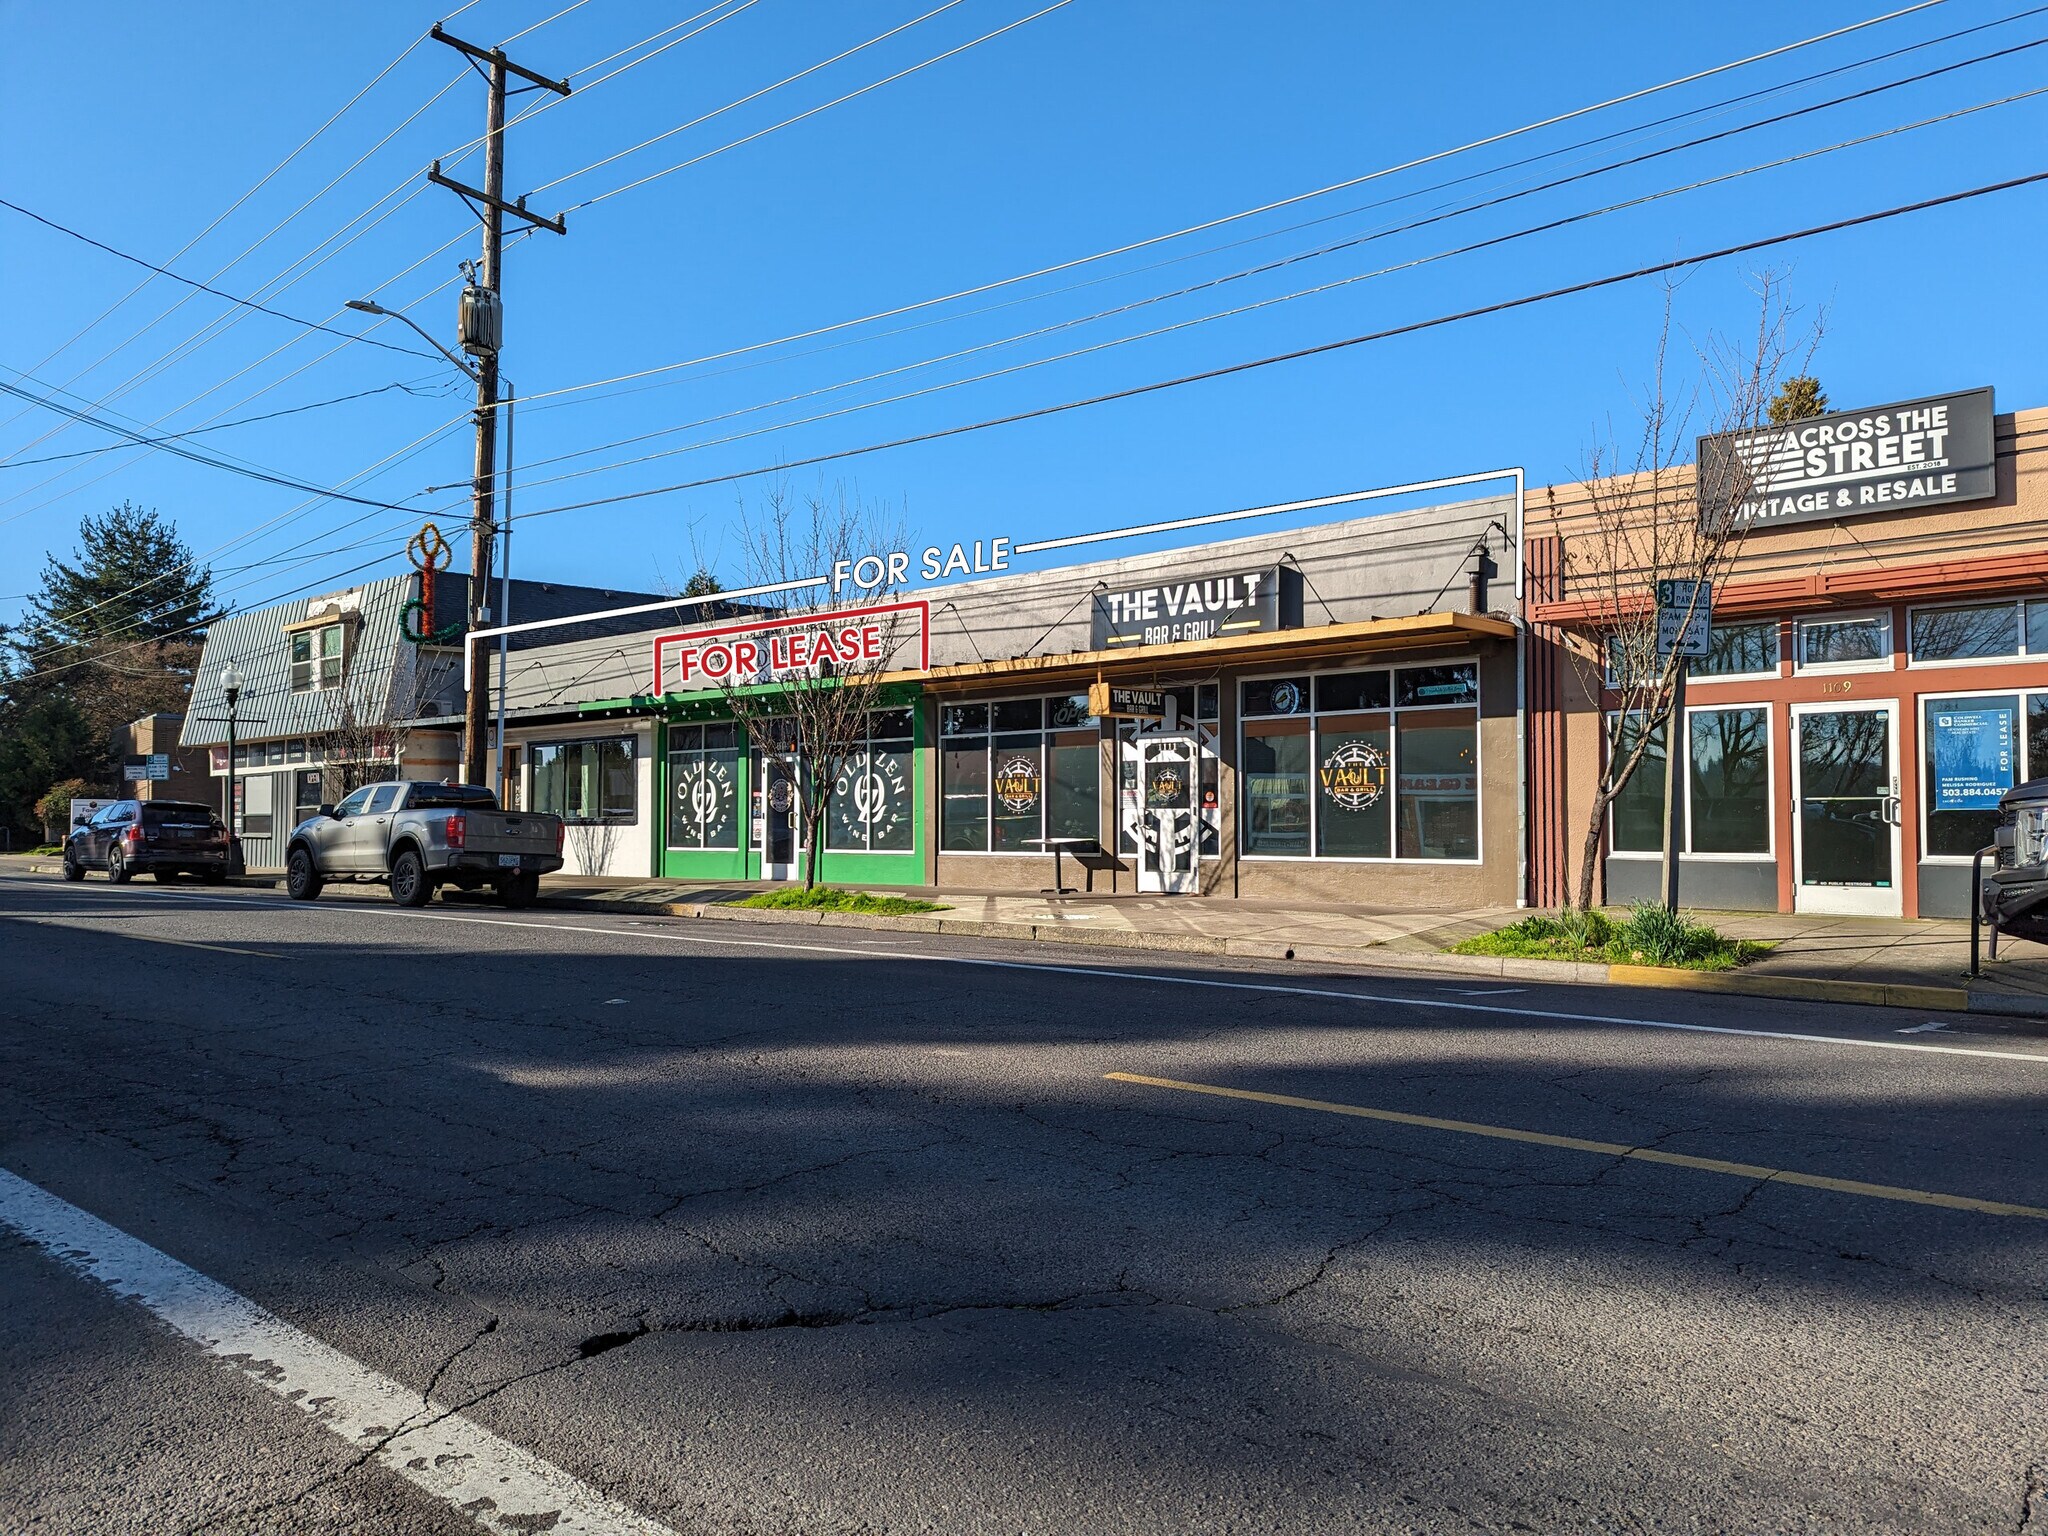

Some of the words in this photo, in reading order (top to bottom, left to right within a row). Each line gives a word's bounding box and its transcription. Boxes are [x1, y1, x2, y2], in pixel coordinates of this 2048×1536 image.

[1784, 415, 1891, 451] ACROSS
[1896, 405, 1948, 433] THE
[1806, 427, 1949, 478] STREET
[1922, 460, 1941, 469] 2018
[1729, 491, 1829, 522] VINTAGE
[1836, 488, 1853, 507] &
[1860, 474, 1957, 505] RESALE
[1107, 589, 1159, 624] THE
[1162, 573, 1261, 617] VAULT
[1661, 583, 1673, 604] 3
[1145, 625, 1169, 645] BAR
[1172, 624, 1180, 642] &
[1184, 619, 1215, 641] GRILL
[1113, 689, 1130, 704] THE
[1131, 690, 1161, 706] VAULT
[1823, 680, 1852, 694] 1109
[1999, 713, 2008, 746] LEASE
[836, 750, 867, 796] OLD
[874, 749, 906, 795] ZEN
[2000, 751, 2009, 772] FOR
[677, 758, 702, 800] OLD
[708, 757, 733, 798] ZEN
[995, 777, 1042, 793] VAULT
[1320, 767, 1389, 786] VAULT
[1942, 787, 2009, 797] 503.884.0457
[681, 814, 703, 840] WINE
[709, 814, 728, 838] BAR
[841, 813, 867, 842] WINE
[877, 813, 898, 839] BAR
